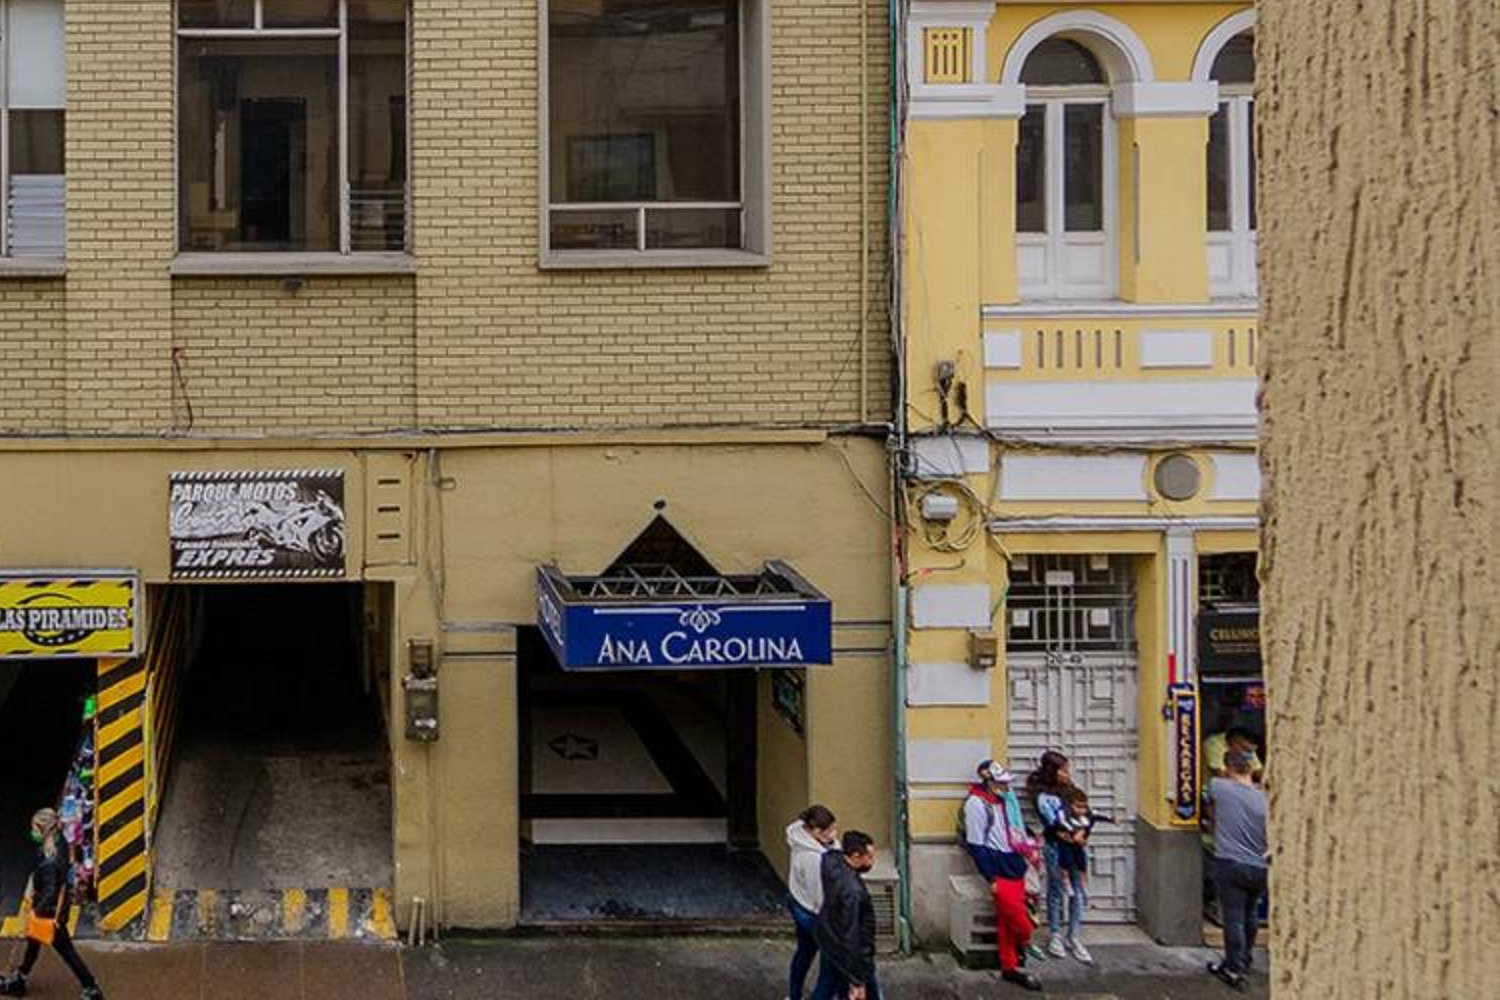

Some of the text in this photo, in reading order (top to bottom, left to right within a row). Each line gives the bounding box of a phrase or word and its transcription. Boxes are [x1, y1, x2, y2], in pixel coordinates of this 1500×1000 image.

[171, 481, 298, 501] PARQUE MOTOS
[176, 549, 276, 567] EXPRES
[28, 607, 131, 631] PIRAMIDES
[597, 631, 803, 664] ANA CAROLINA
